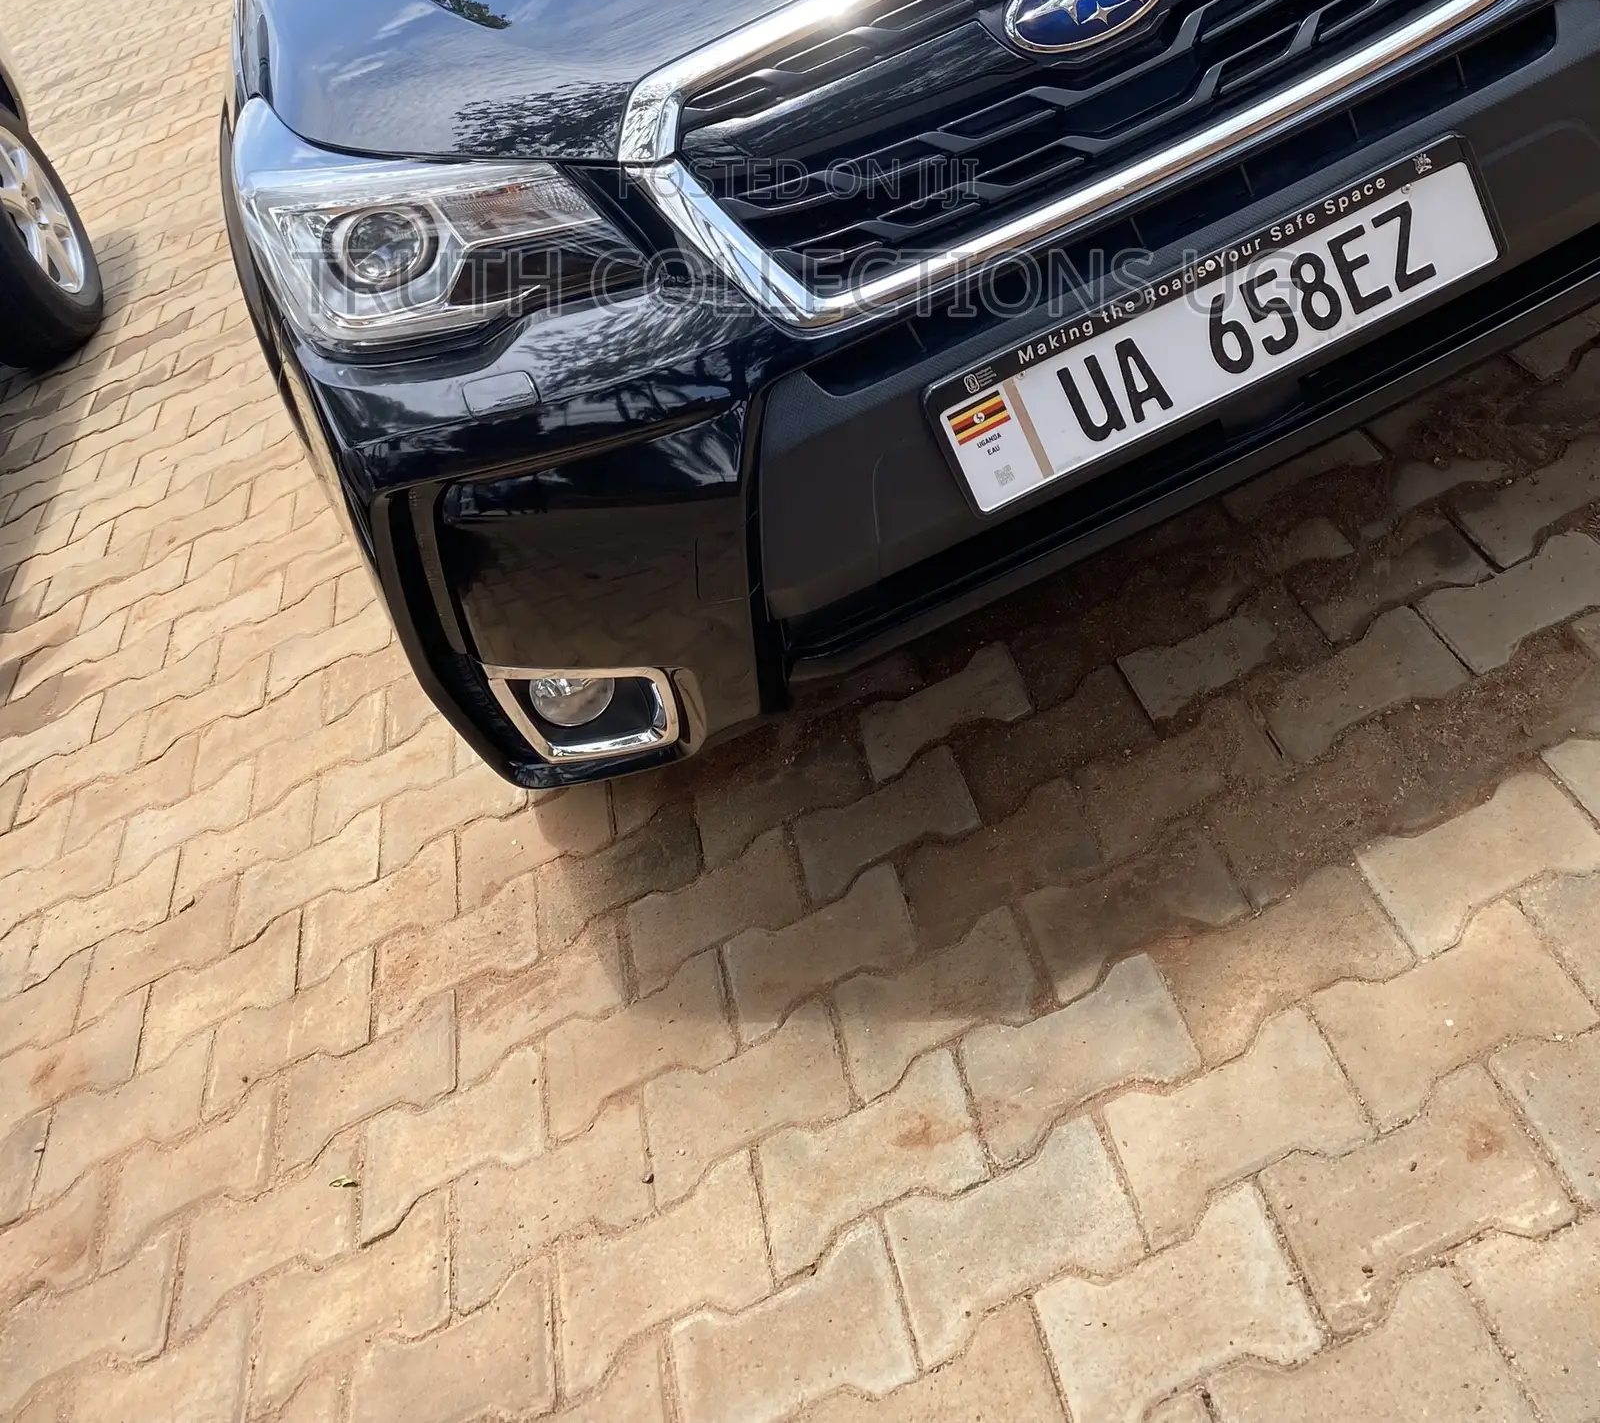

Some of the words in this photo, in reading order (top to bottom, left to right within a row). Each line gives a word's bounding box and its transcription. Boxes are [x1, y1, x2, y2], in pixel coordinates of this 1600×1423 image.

[1017, 320, 1094, 364] Making
[1101, 299, 1135, 323] the
[1144, 265, 1207, 304] Roads
[1214, 238, 1261, 268] Your
[1270, 212, 1316, 241] Safe
[1324, 177, 1386, 215] Space
[1056, 337, 1174, 442] UA
[1207, 200, 1437, 375] 658EZ
[976, 432, 1002, 449] UGANDA
[987, 446, 1001, 456] EAU
